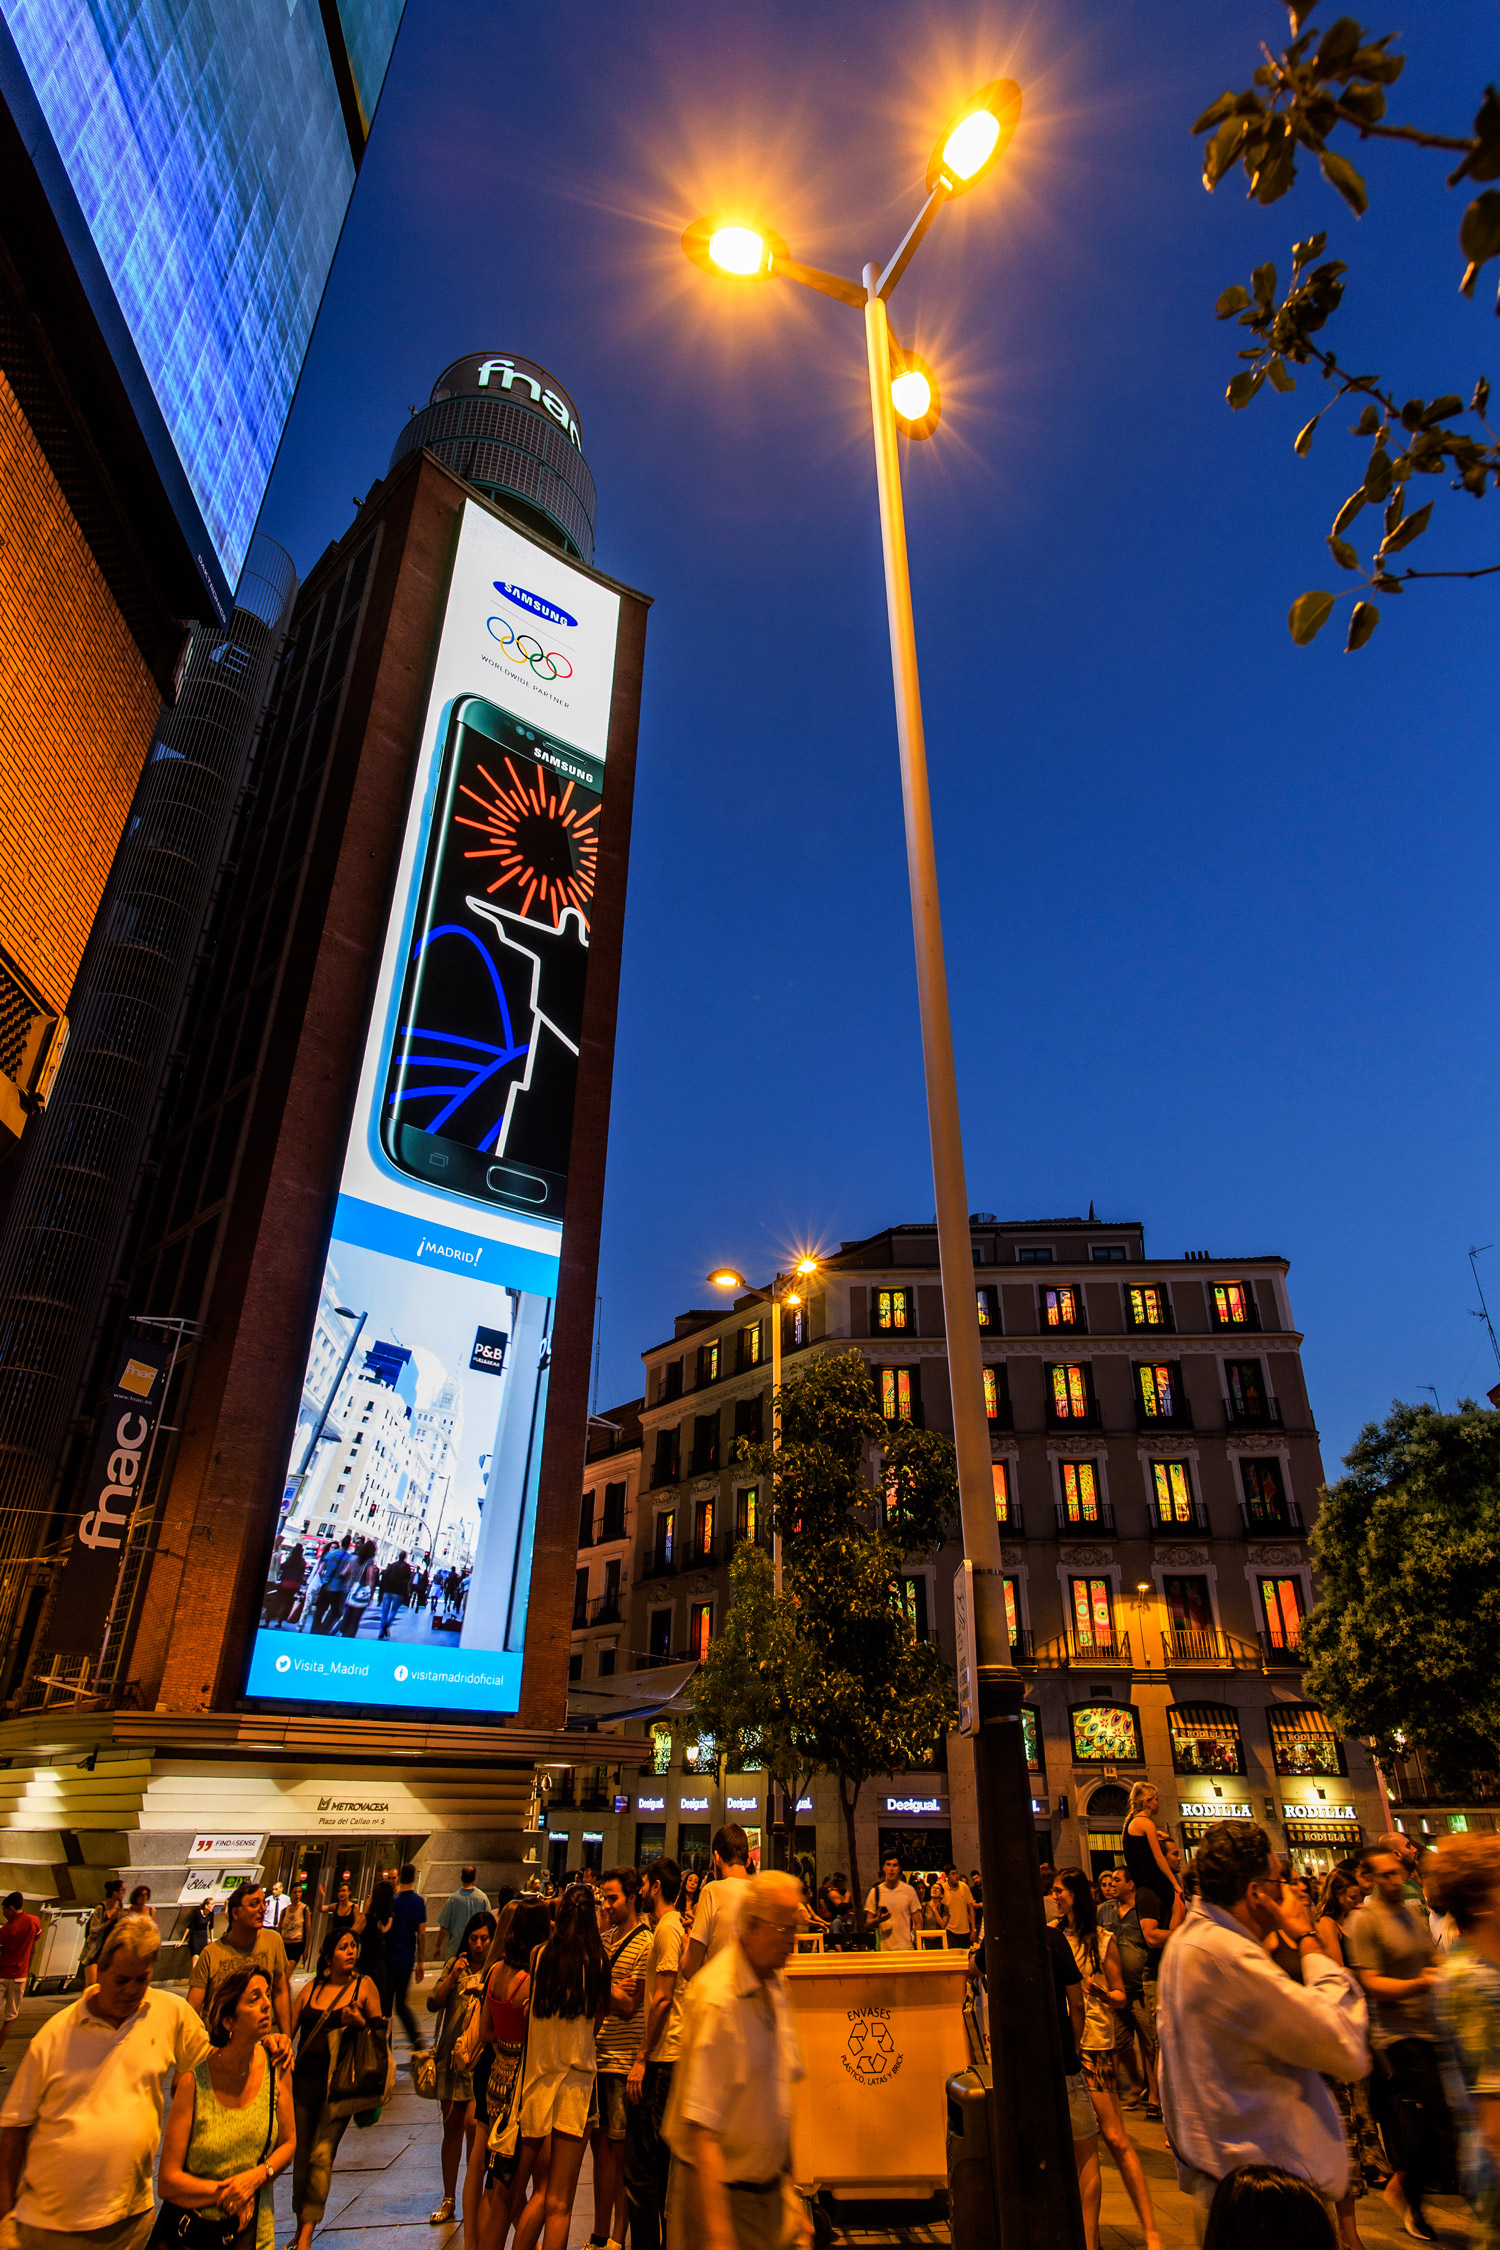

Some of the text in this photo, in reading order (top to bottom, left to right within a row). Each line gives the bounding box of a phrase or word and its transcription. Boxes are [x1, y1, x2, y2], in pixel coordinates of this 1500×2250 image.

[504, 582, 569, 627] SAMSUNG
[481, 654, 570, 708] WORLDWIDE PARTNER
[534, 747, 594, 783] SAMSUNG
[417, 1236, 483, 1267] ¡MADRID!
[474, 1343, 503, 1360] P&B
[126, 1364, 156, 1380] fnac
[78, 1411, 148, 1550] fnac
[294, 1658, 369, 1676] Visita_Madrid
[411, 1669, 504, 1686] visitamadridoficial
[1187, 1730, 1227, 1738] RODILLA
[1287, 1733, 1328, 1741] RODILLA
[331, 1802, 389, 1811] METROVACESA
[887, 1798, 940, 1813] Desigual.
[1181, 1803, 1252, 1817] RODILLA
[1283, 1804, 1357, 1819] RODILLA
[318, 1817, 336, 1825] Plaza
[337, 1817, 348, 1825] del
[350, 1817, 370, 1825] Callao
[215, 1839, 257, 1847] FINDASENSE
[1304, 1832, 1346, 1841] RODILLA
[847, 2007, 891, 2021] ENVASES
[867, 2075, 888, 2086] LATAS
[891, 2053, 904, 2074] BRICK
